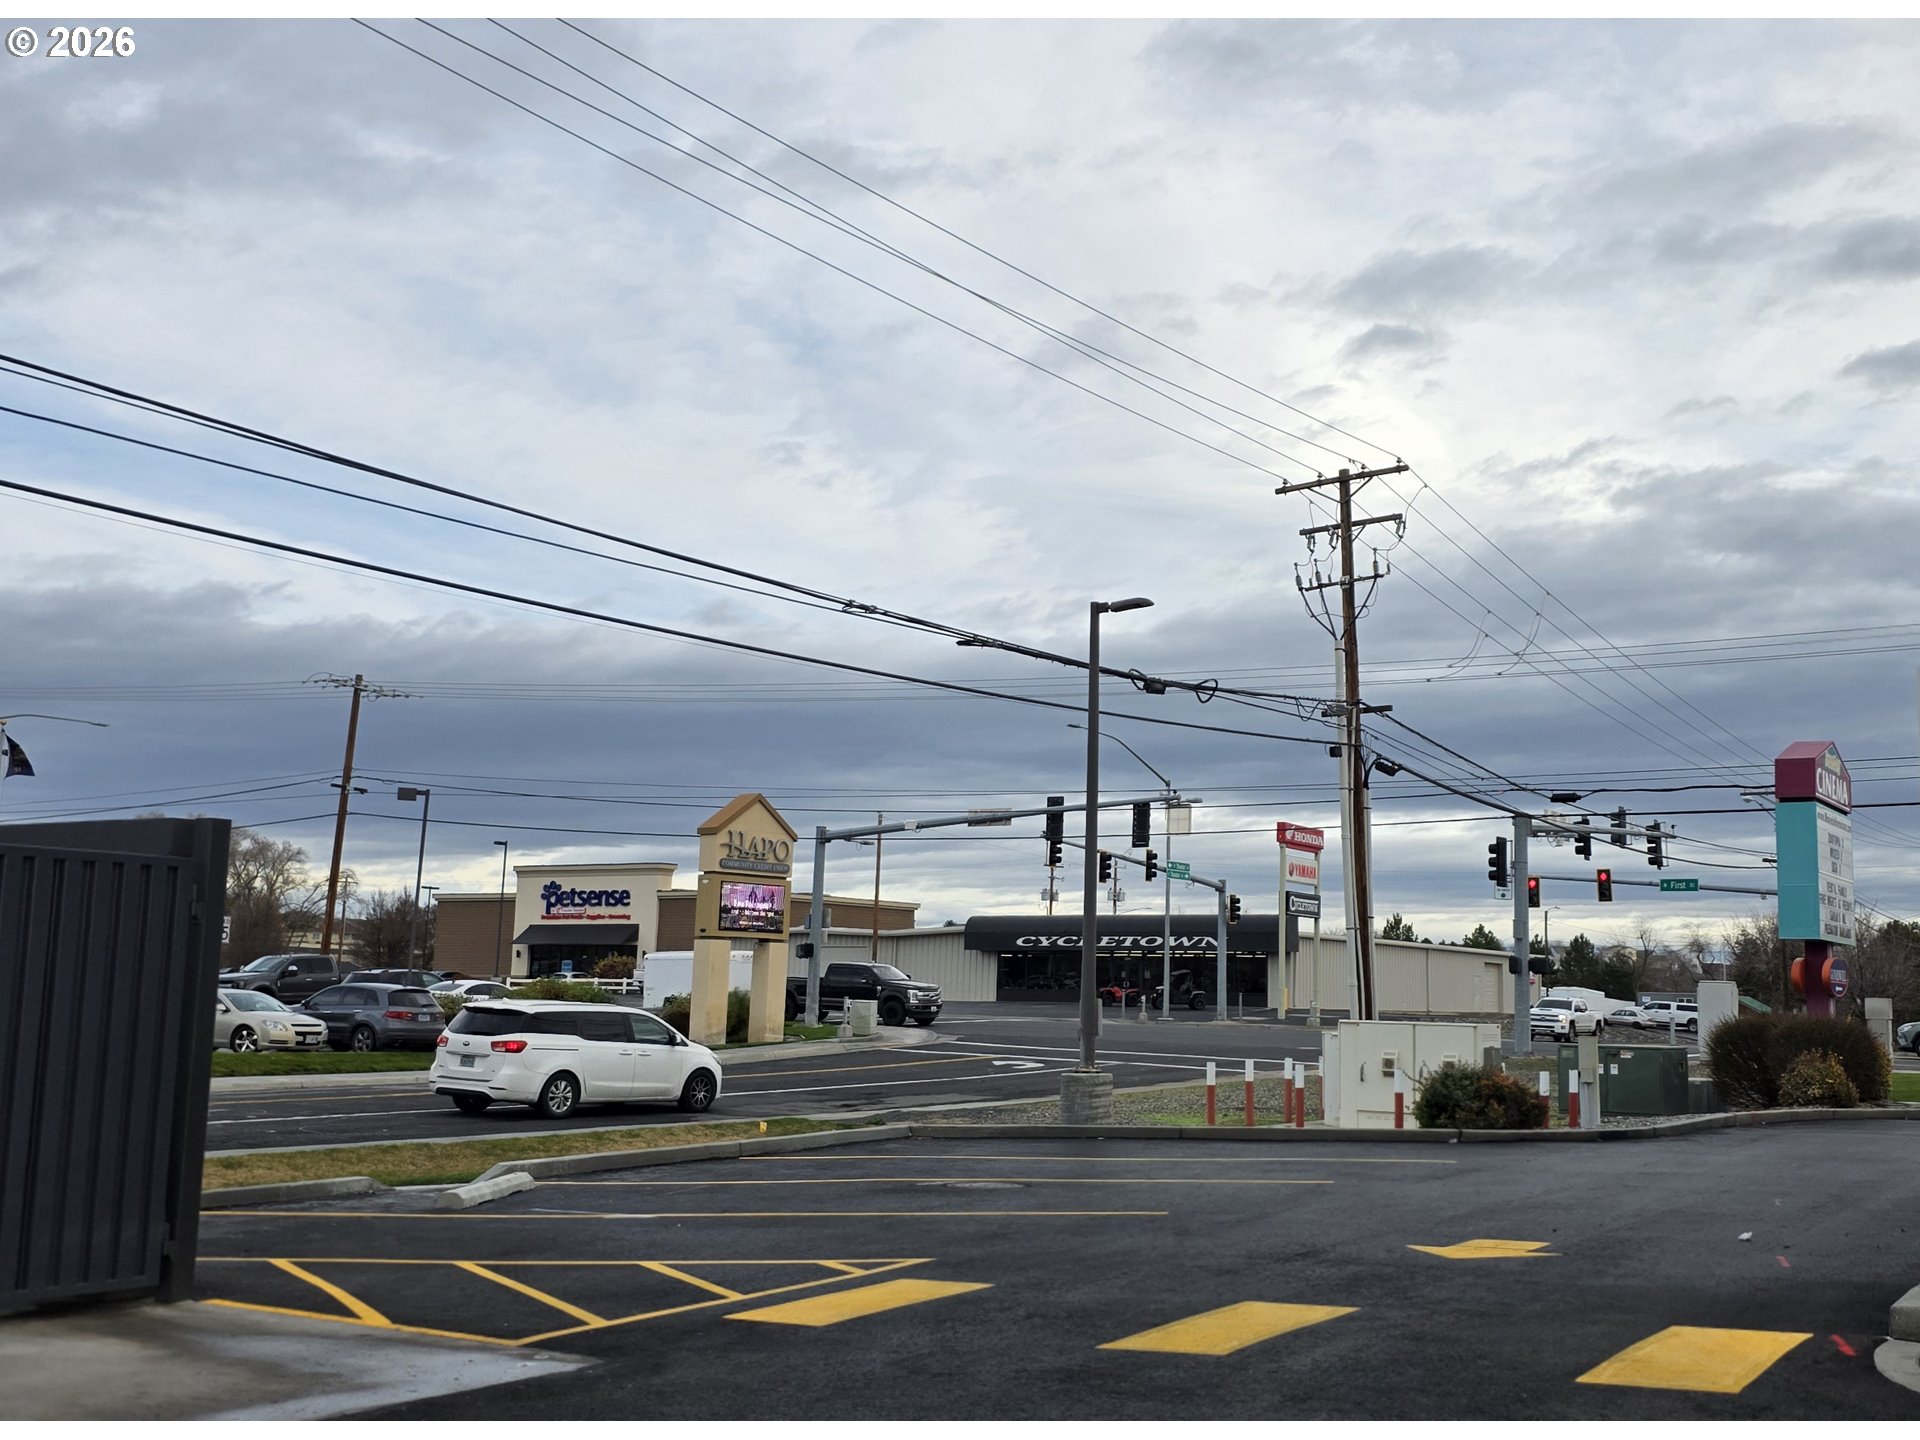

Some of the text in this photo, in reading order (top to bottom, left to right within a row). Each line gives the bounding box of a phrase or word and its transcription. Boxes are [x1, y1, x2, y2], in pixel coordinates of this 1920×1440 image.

[1816, 767, 1849, 806] CINEMA
[720, 829, 790, 862] HAPO
[1295, 831, 1324, 846] HONDA
[1295, 863, 1317, 880] YAMAHA
[1670, 881, 1687, 889] First
[544, 887, 631, 915] petsense
